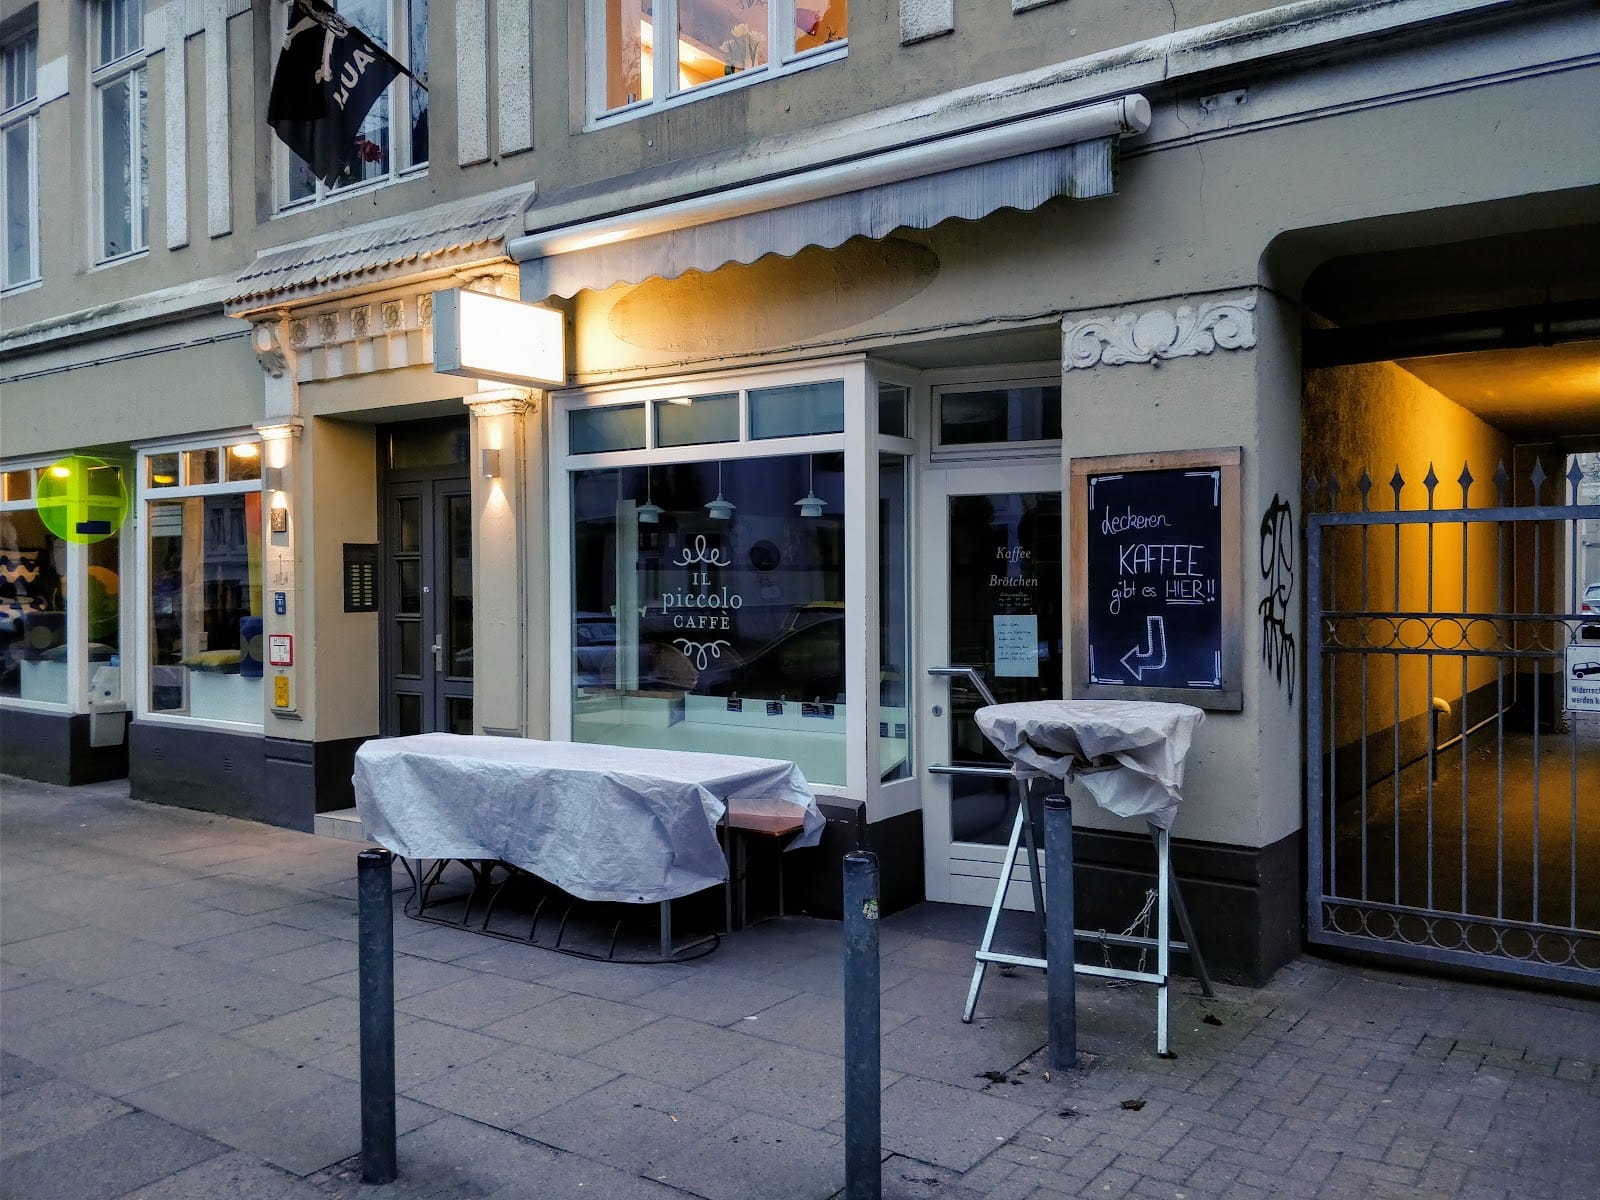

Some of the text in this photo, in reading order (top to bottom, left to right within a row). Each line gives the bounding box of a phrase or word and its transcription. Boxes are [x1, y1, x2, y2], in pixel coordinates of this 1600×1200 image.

[996, 546, 1031, 563] Kaffee
[1119, 543, 1205, 577] KAFFEE
[692, 572, 711, 586] IL
[989, 574, 1038, 587] Brötchen
[662, 587, 743, 615] piccolo
[1110, 579, 1216, 614] gibt es HIER!!
[673, 610, 730, 630] CAFFÈ
